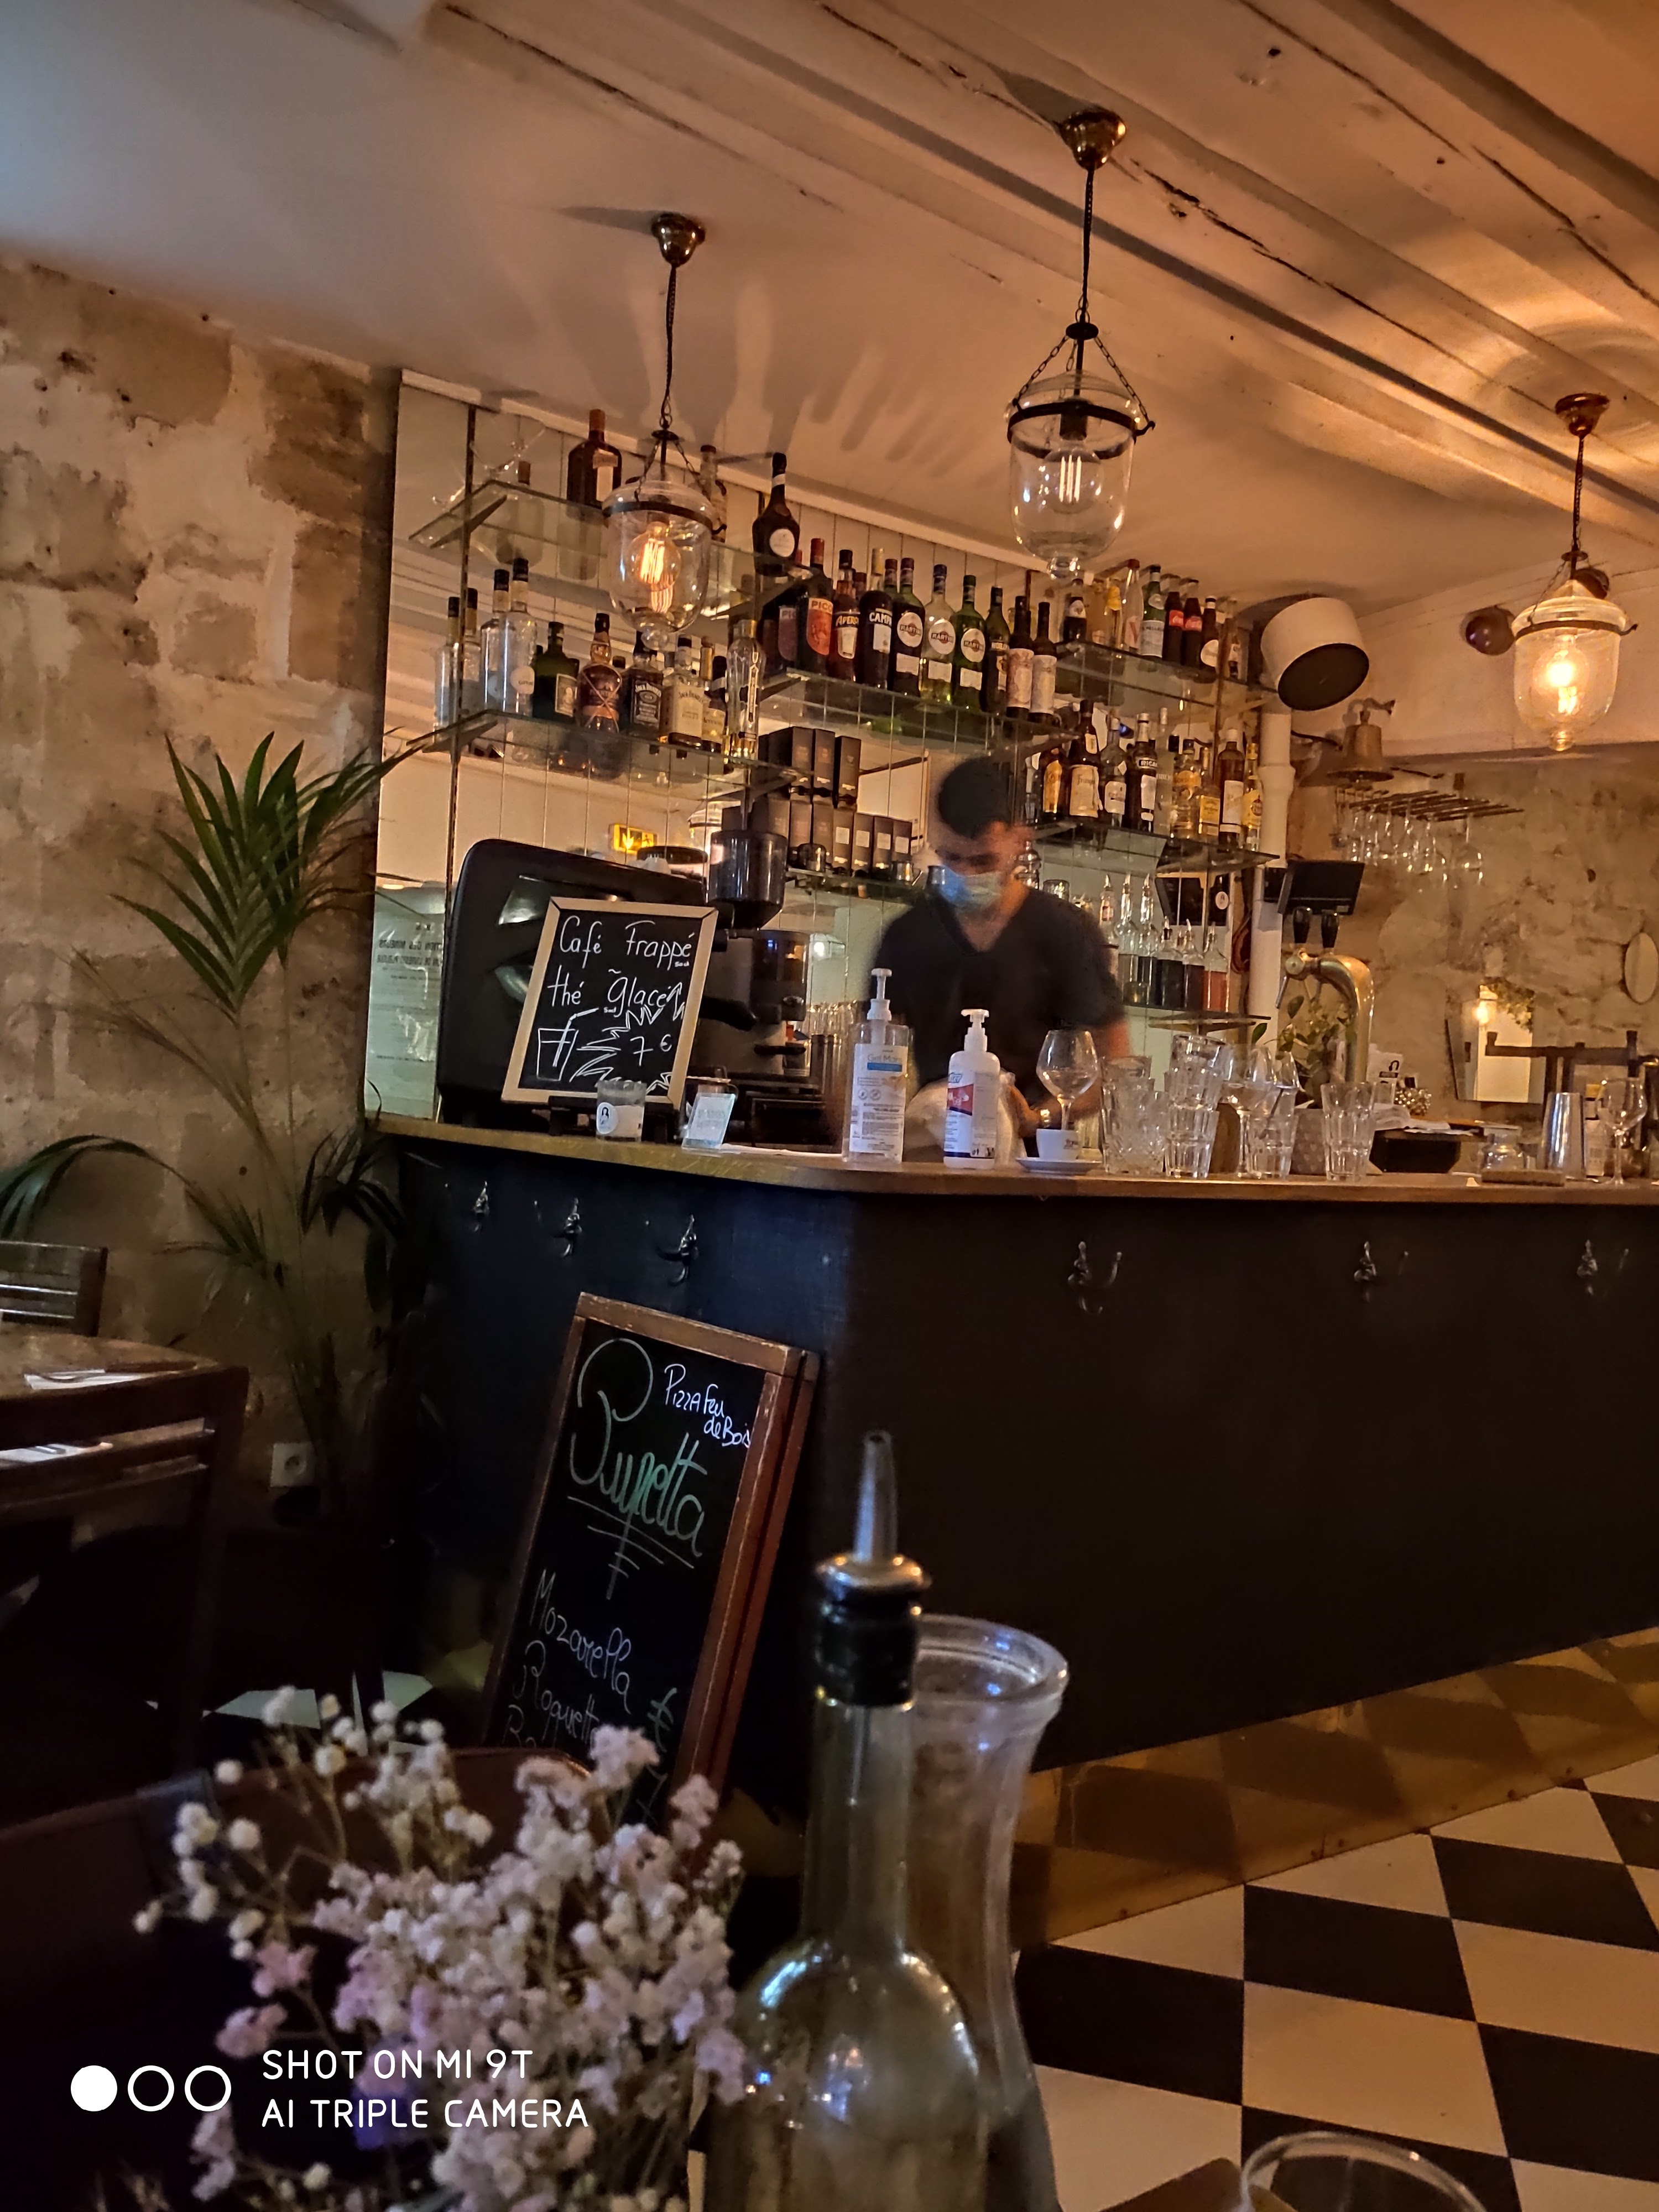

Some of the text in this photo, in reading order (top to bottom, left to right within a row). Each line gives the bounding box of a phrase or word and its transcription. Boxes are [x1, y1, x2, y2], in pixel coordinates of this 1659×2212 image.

[559, 915, 695, 971] Café Frappé
[511, 1639, 601, 1750] Roquett
